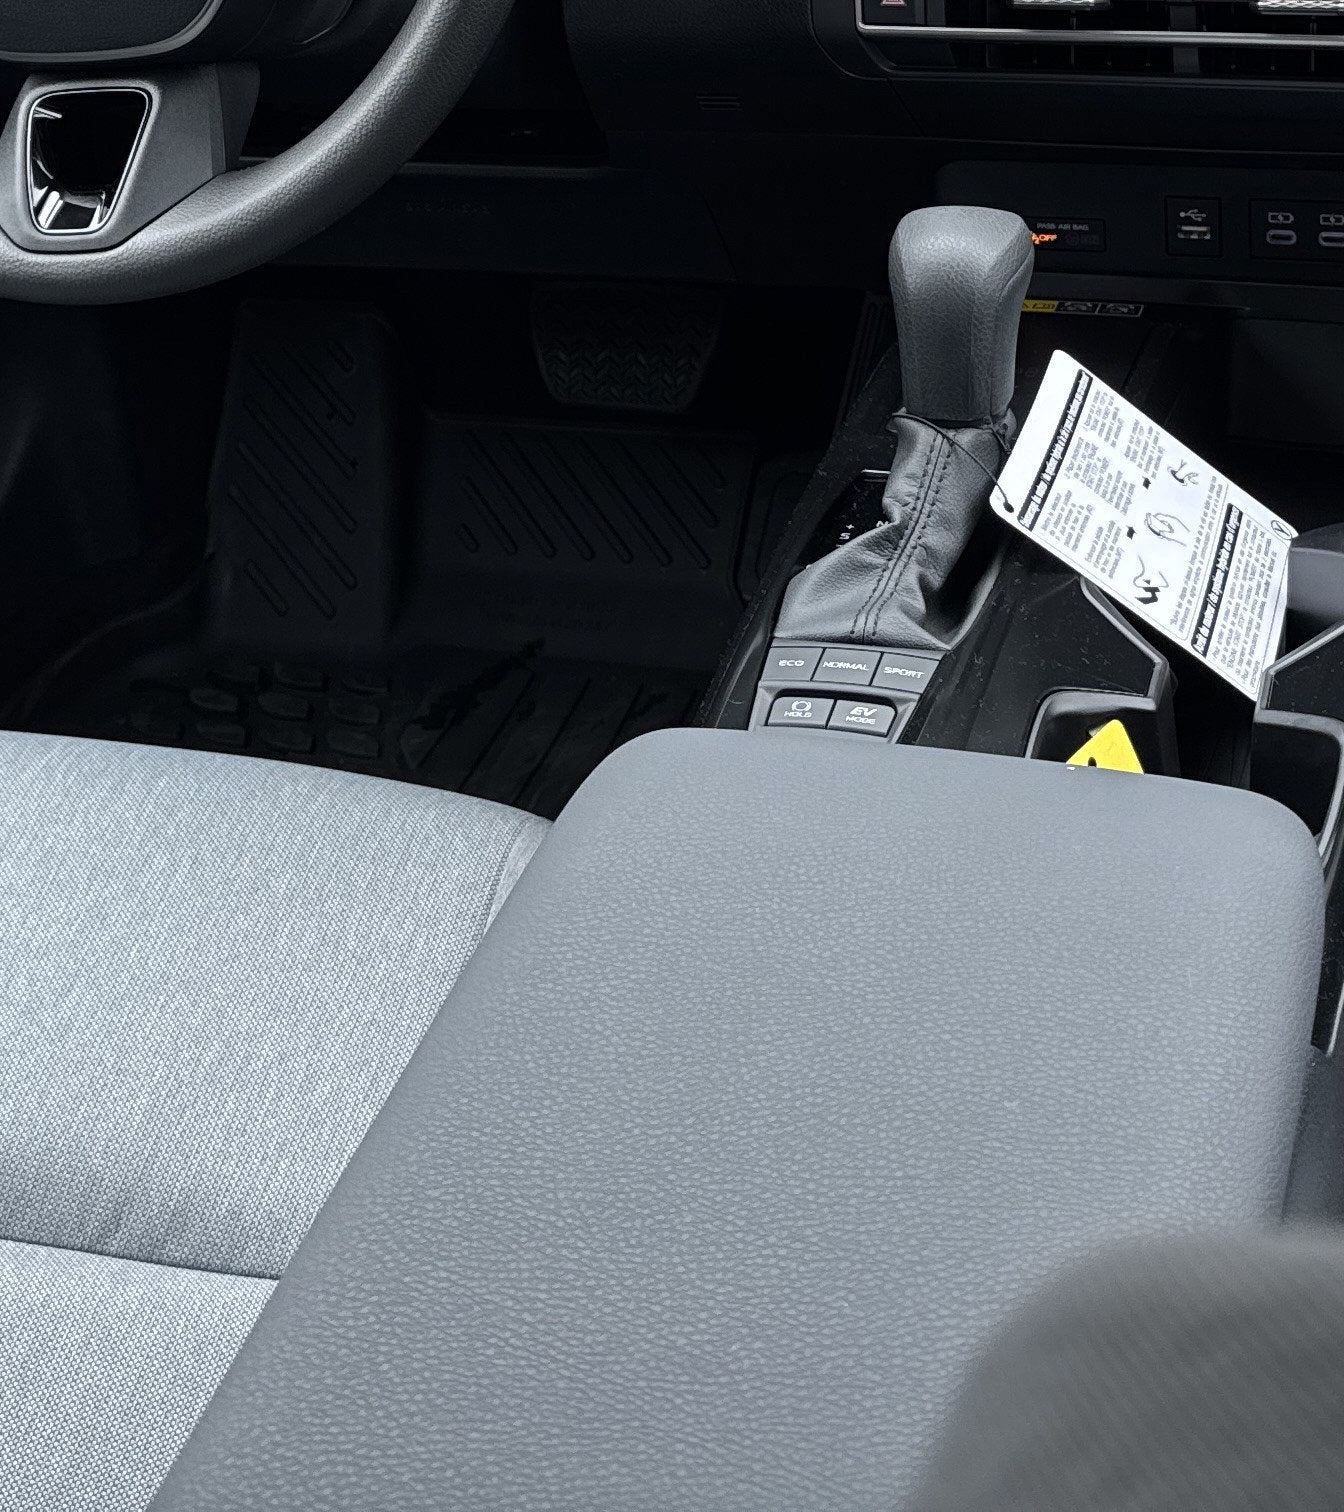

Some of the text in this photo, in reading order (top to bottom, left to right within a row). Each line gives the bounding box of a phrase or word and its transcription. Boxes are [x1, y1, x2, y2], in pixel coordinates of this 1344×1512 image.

[778, 659, 805, 667] ECO
[822, 661, 869, 671] NORMAL
[883, 666, 925, 679] SPORT
[850, 706, 877, 716] EV
[845, 715, 877, 725] MODE
